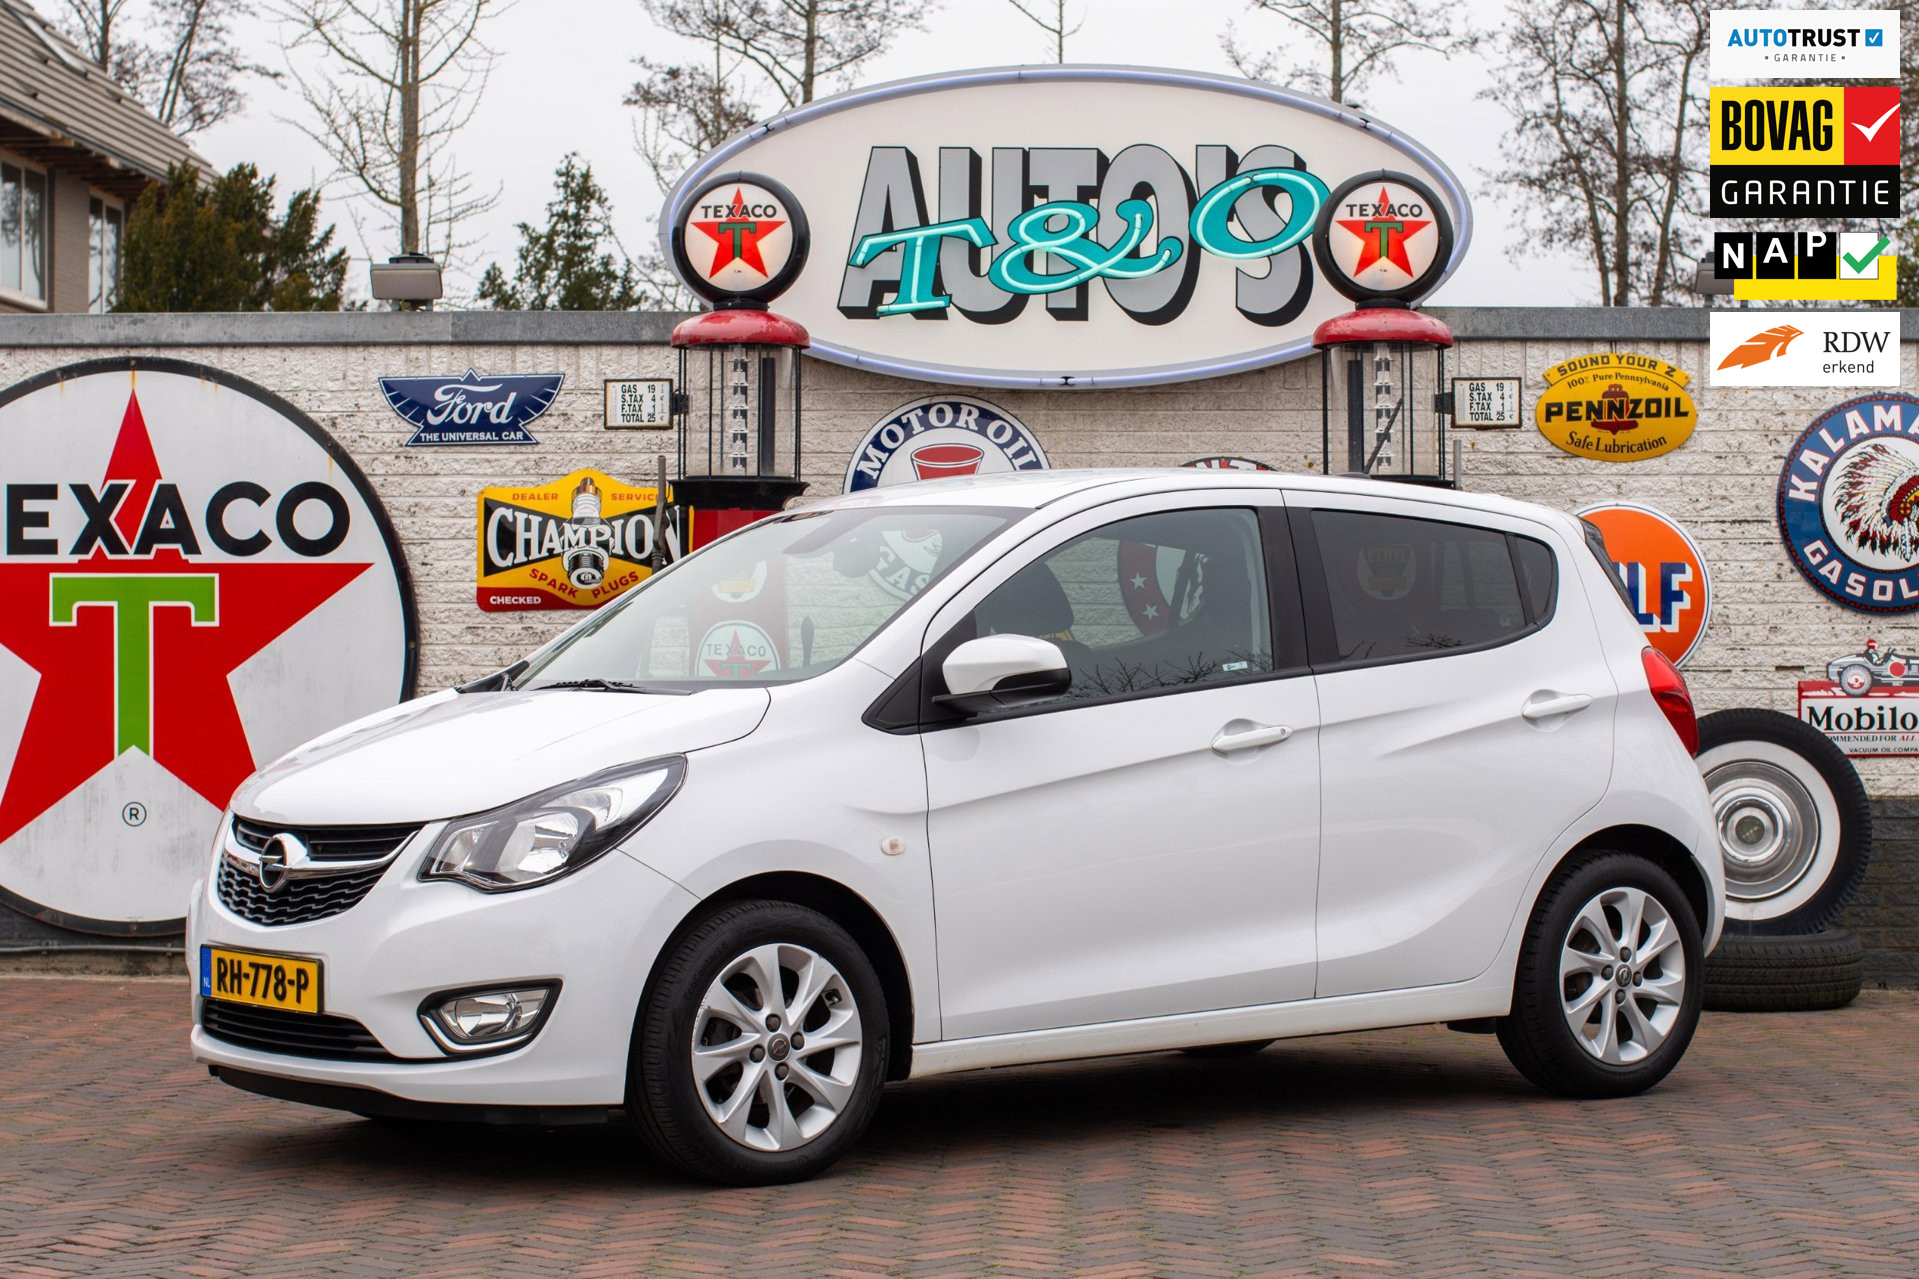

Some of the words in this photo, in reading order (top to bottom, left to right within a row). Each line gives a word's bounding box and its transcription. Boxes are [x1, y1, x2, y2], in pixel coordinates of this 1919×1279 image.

[700, 204, 777, 219] TEXACO
[1346, 203, 1423, 218] TEXACO
[1557, 354, 1610, 377] SOUND
[1616, 354, 1658, 371] YOUR
[1664, 365, 1677, 378] Z
[621, 384, 638, 394] GAS
[647, 384, 656, 394] 19
[1469, 382, 1486, 392] GAS
[1496, 382, 1505, 392] 19
[1592, 373, 1613, 382] Pure
[1615, 371, 1670, 392] Pennsylvania
[426, 383, 517, 426] Ford
[621, 394, 644, 404] S.TAX
[651, 394, 656, 404] 4
[1469, 392, 1492, 402] S.TAX
[1500, 392, 1505, 402] 4
[621, 403, 643, 413] F.TAX
[1469, 402, 1491, 412] F.TAX
[1545, 397, 1690, 423] PENNZOIL
[621, 413, 644, 423] TOTAL
[647, 413, 656, 423] 25
[1469, 411, 1494, 421] TOTAL
[1496, 411, 1506, 421] 25
[420, 433, 440, 442] THE
[442, 432, 498, 441] UNIVERSAL
[502, 431, 524, 440] CAR
[857, 403, 980, 480] MOTOR
[1566, 430, 1594, 451] Safe
[1596, 436, 1668, 454] Lubrication
[512, 492, 559, 501] DEALER
[611, 493, 659, 501] SERVIC
[6, 481, 351, 557] EXACO
[529, 567, 579, 599] SPARK
[591, 571, 639, 599] PLUGS
[489, 595, 542, 605] CHECKED
[1611, 561, 1694, 633] LF
[706, 643, 767, 657] TEXACO
[50, 574, 218, 757] T
[1807, 705, 1918, 731] Mobilo
[203, 977, 211, 988] NL
[216, 957, 309, 1005] RH-778-P
